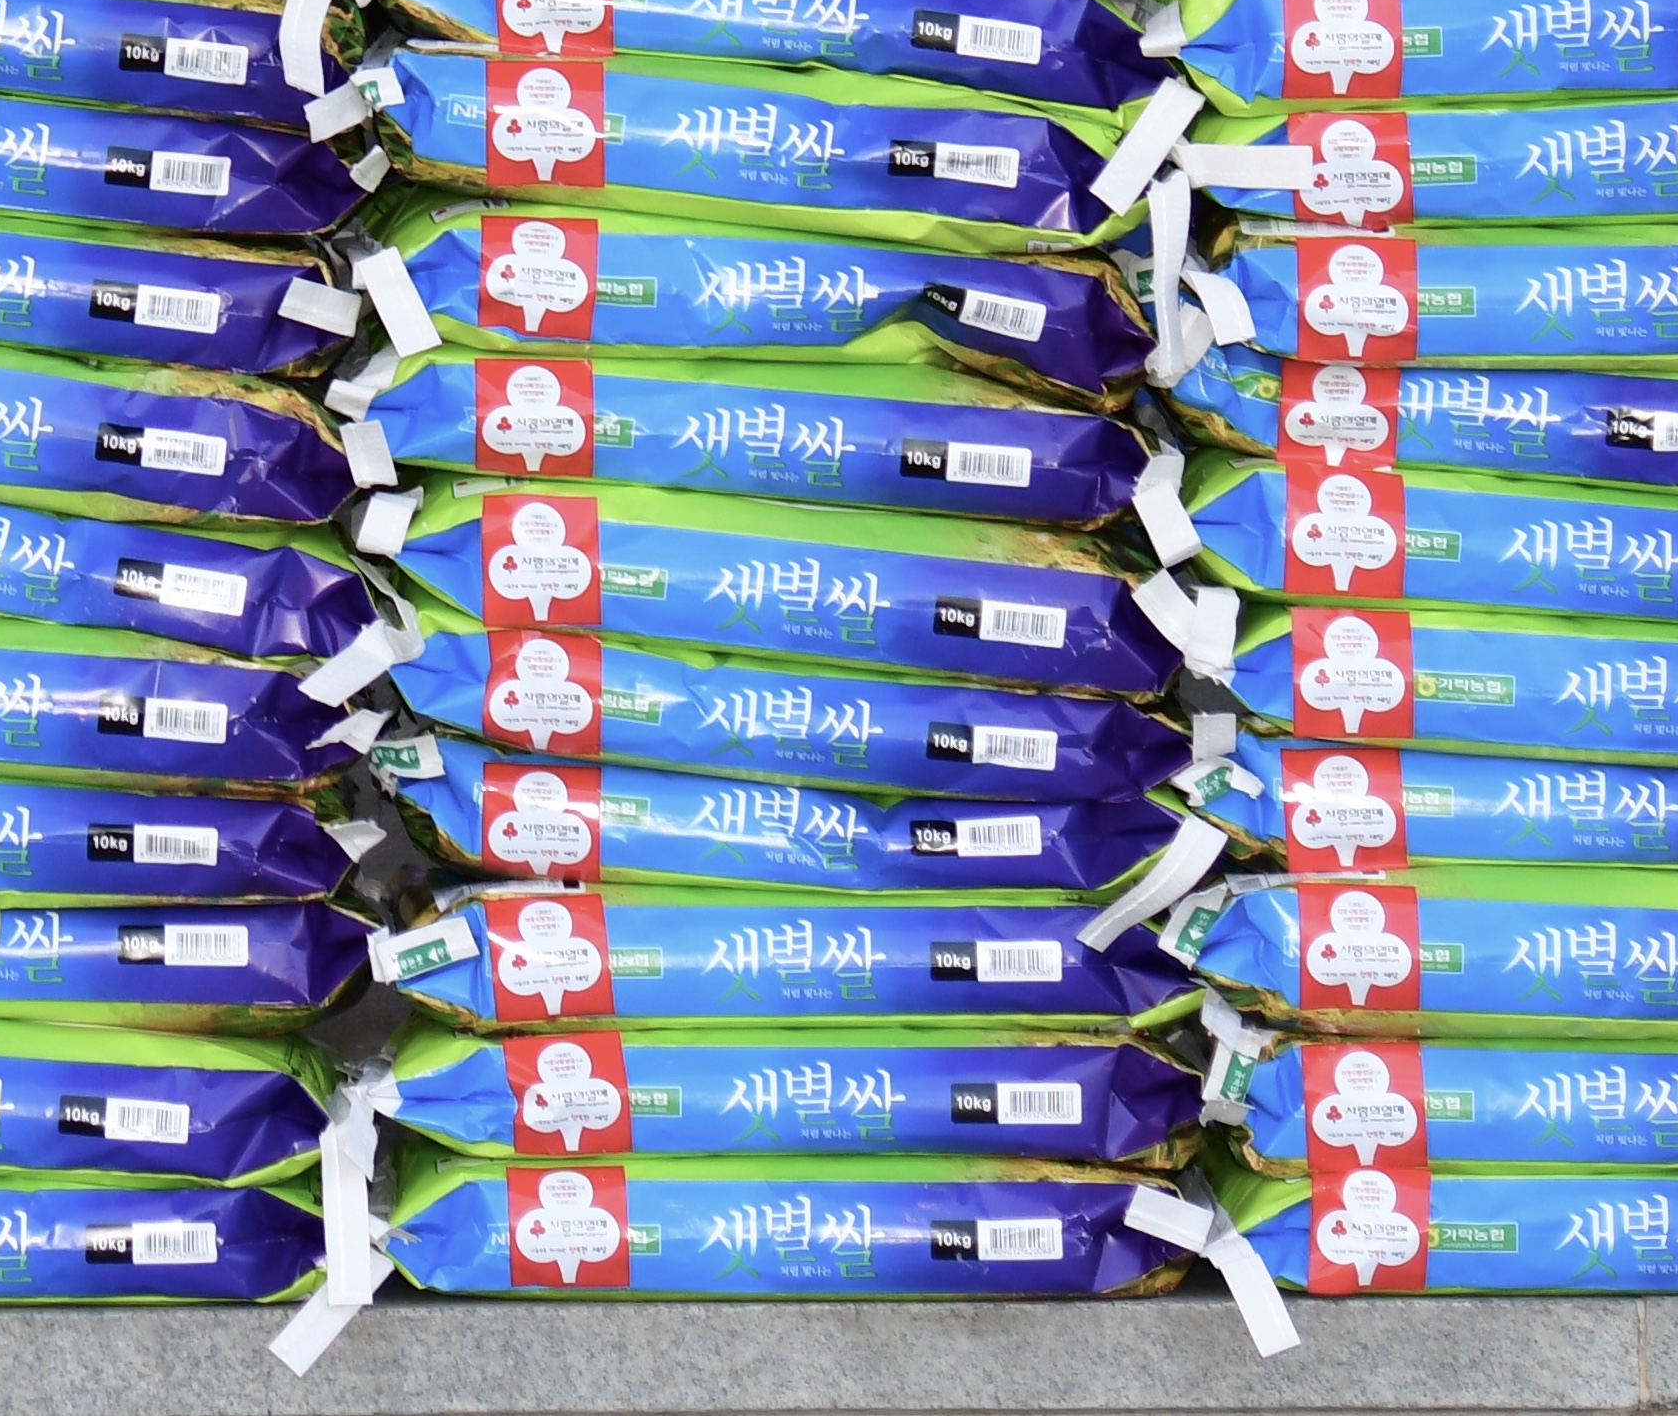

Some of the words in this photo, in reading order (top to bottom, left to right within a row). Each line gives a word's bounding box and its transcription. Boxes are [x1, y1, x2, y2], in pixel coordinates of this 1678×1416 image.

[125, 43, 161, 63] 10kg
[92, 835, 128, 854] 10kg
[935, 952, 971, 970] 10kg
[956, 1094, 992, 1113] 10kg
